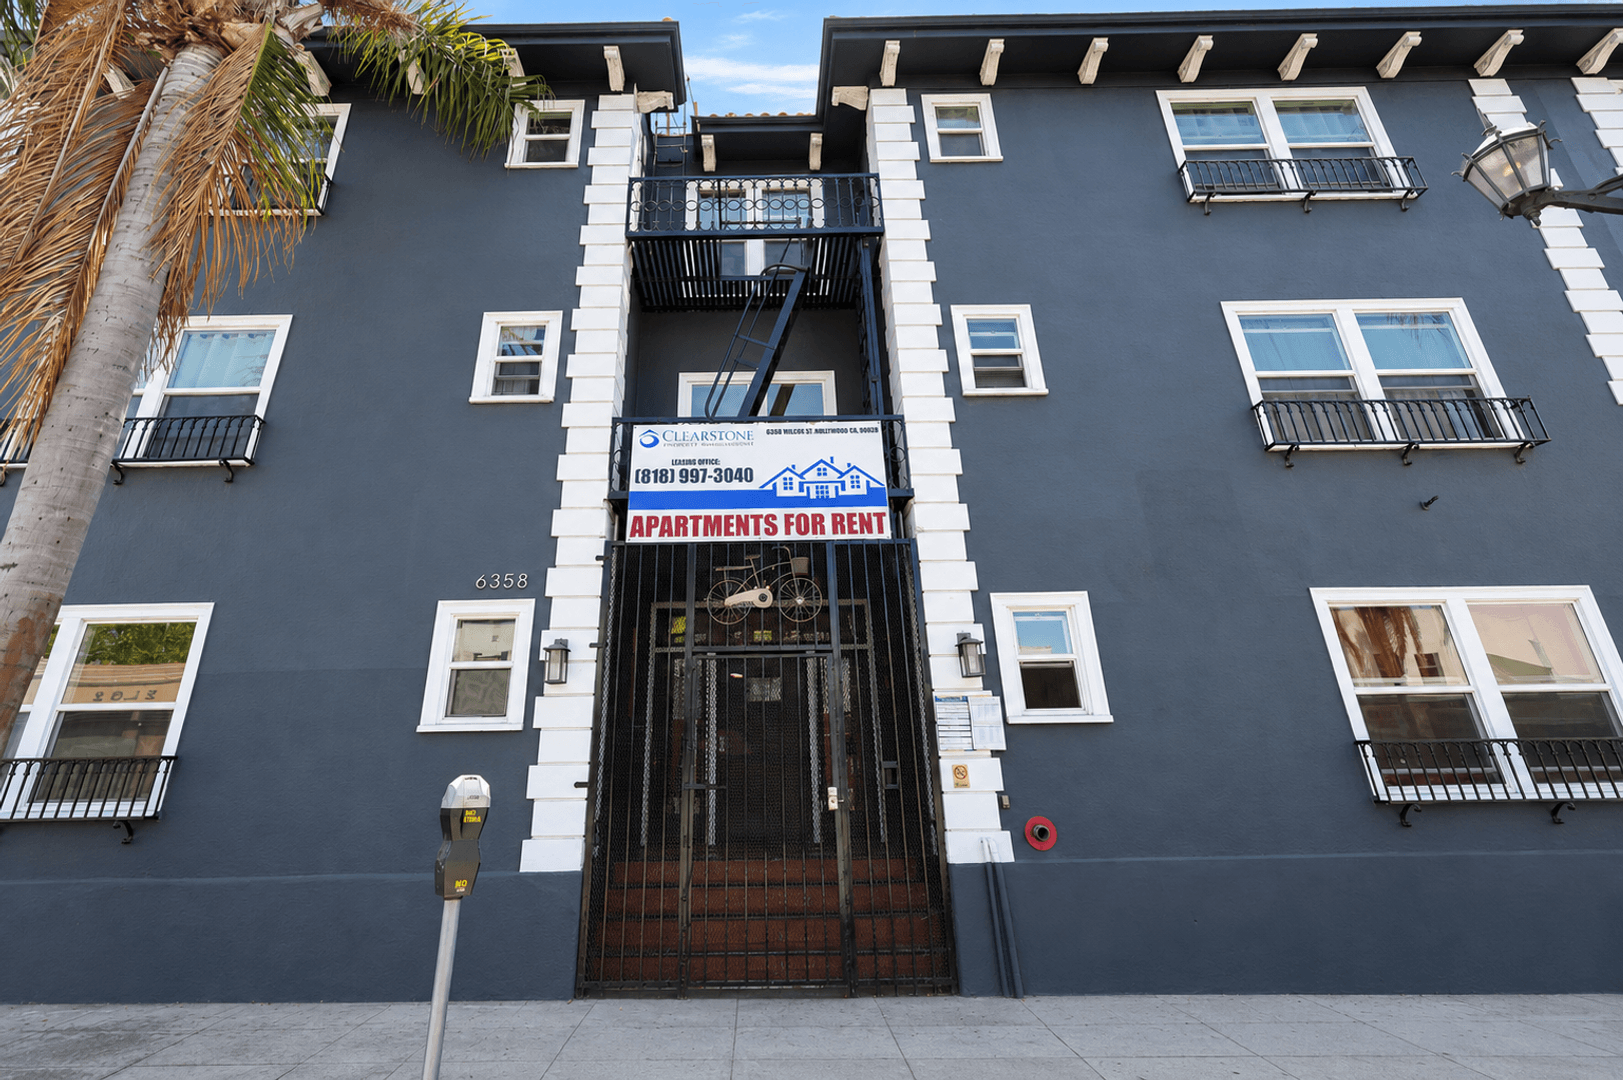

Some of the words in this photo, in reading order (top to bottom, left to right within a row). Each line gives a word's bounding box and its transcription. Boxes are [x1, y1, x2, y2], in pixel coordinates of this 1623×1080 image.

[662, 429, 754, 442] CLEARSTONE
[671, 458, 697, 466] LEASING
[634, 468, 675, 484] (818)
[678, 467, 754, 484] 997-3040
[629, 514, 778, 537] APARTMENTS
[784, 512, 826, 536] FOR
[831, 511, 886, 535] RENT
[475, 573, 528, 589] 6358
